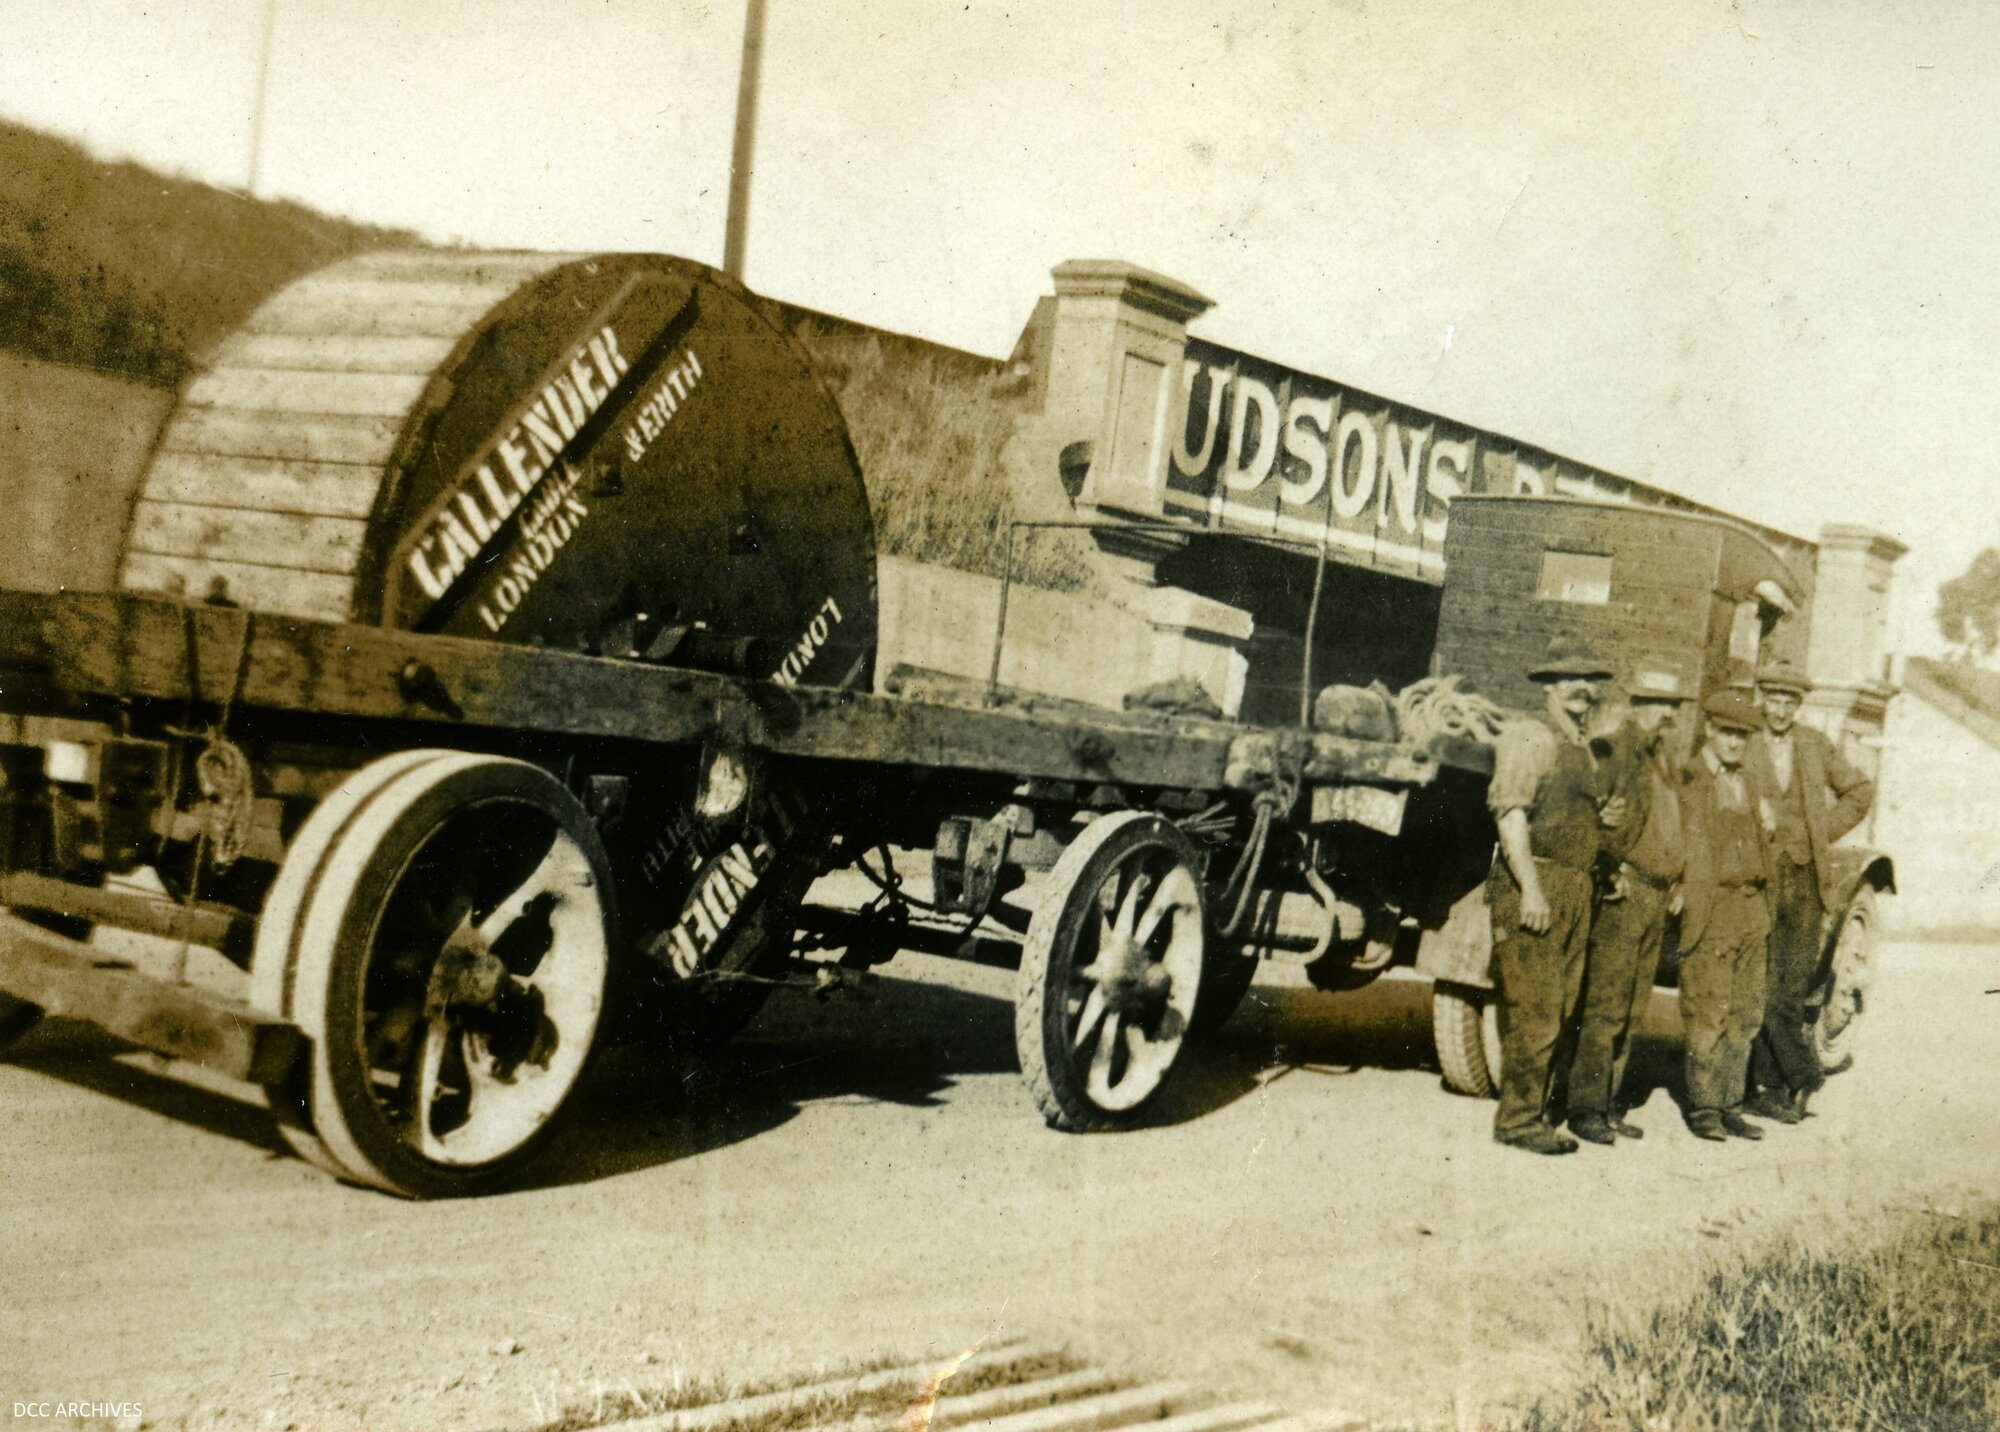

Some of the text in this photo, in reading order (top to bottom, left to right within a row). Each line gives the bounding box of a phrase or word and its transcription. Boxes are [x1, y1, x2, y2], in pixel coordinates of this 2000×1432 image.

[409, 326, 629, 599] CALLENDER
[480, 498, 589, 633] LONDON
[771, 598, 843, 686] LOND
